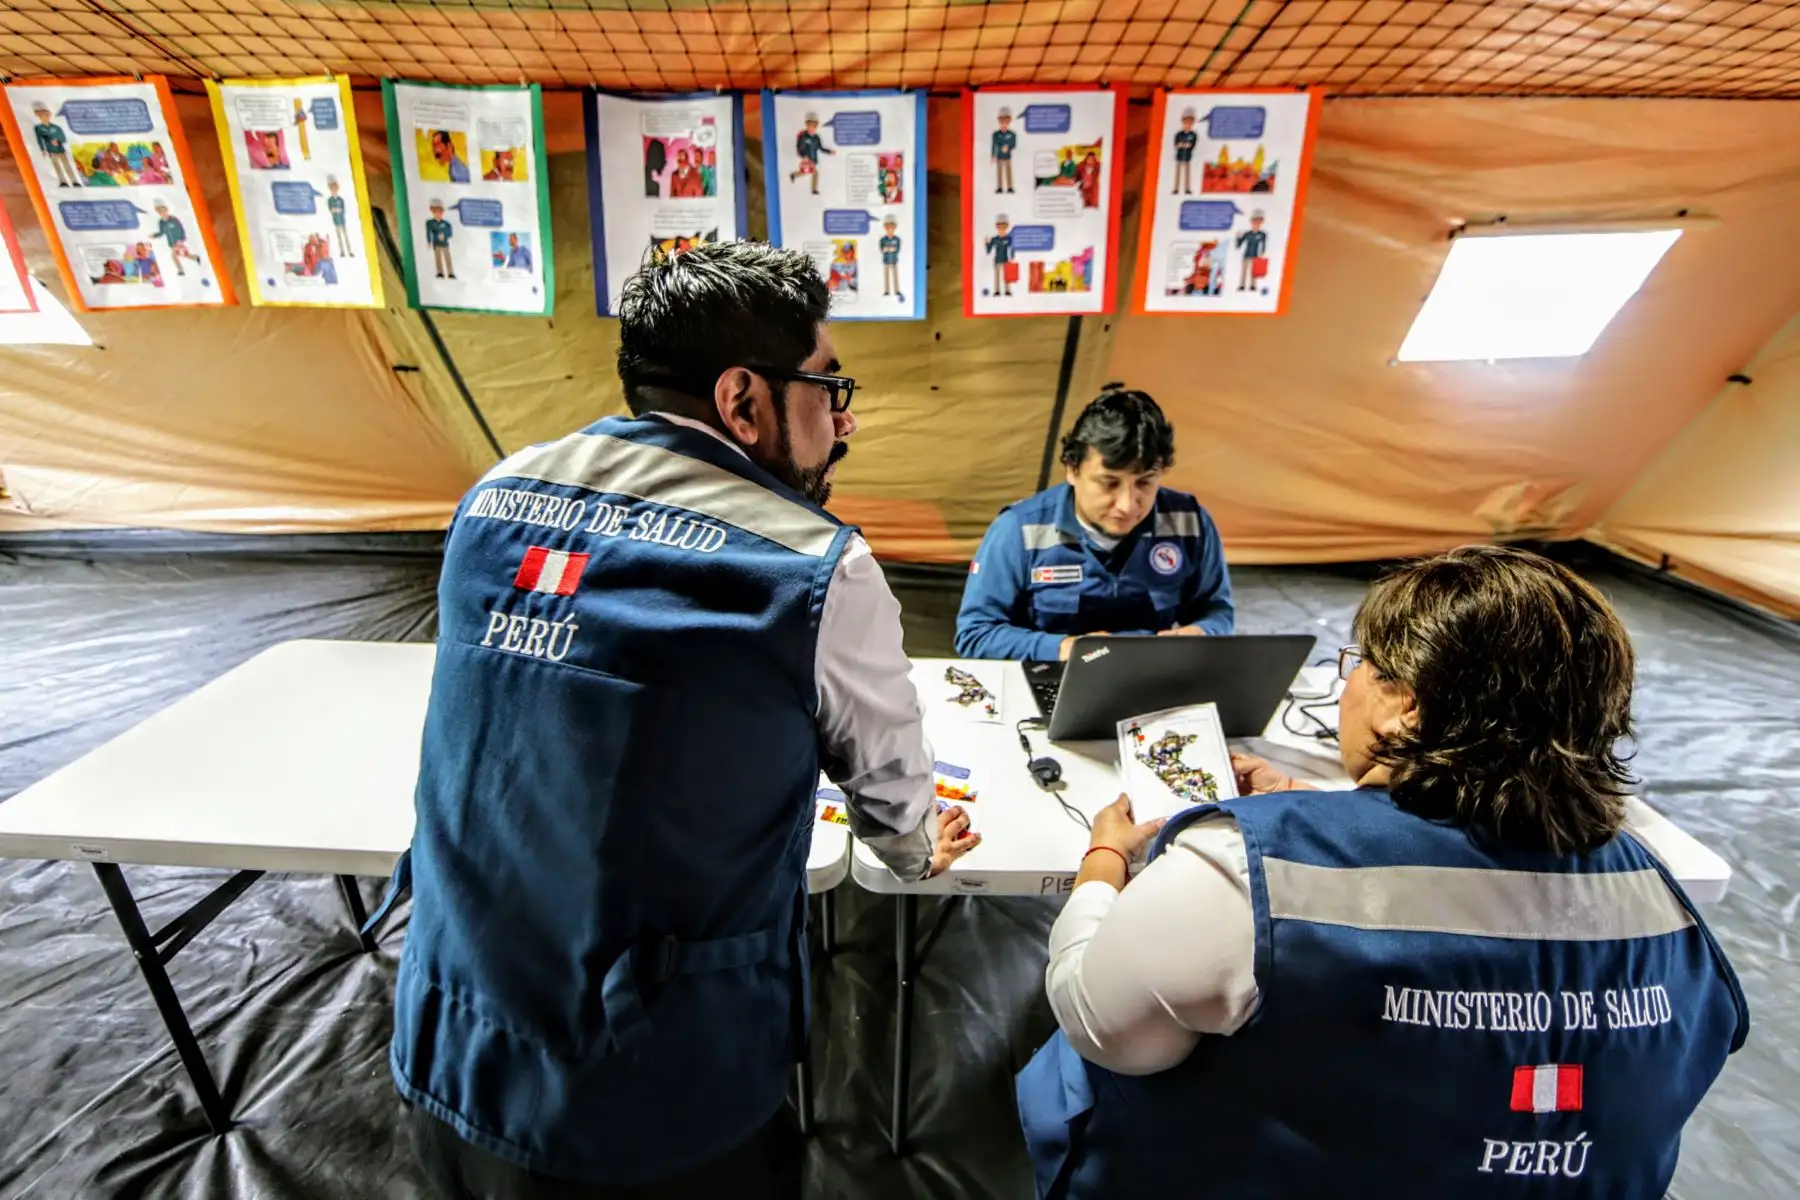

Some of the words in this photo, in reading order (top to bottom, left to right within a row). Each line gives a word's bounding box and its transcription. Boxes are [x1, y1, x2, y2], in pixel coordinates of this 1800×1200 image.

[465, 488, 587, 532] MINISTERIO
[586, 502, 629, 537] DE
[629, 510, 727, 553] SALUD
[480, 612, 579, 662] PERÚ
[1381, 985, 1552, 1032] MINISTERIO
[1561, 990, 1597, 1030] DE
[1604, 984, 1672, 1029] SALUD
[1477, 1131, 1593, 1178] PERÚ
